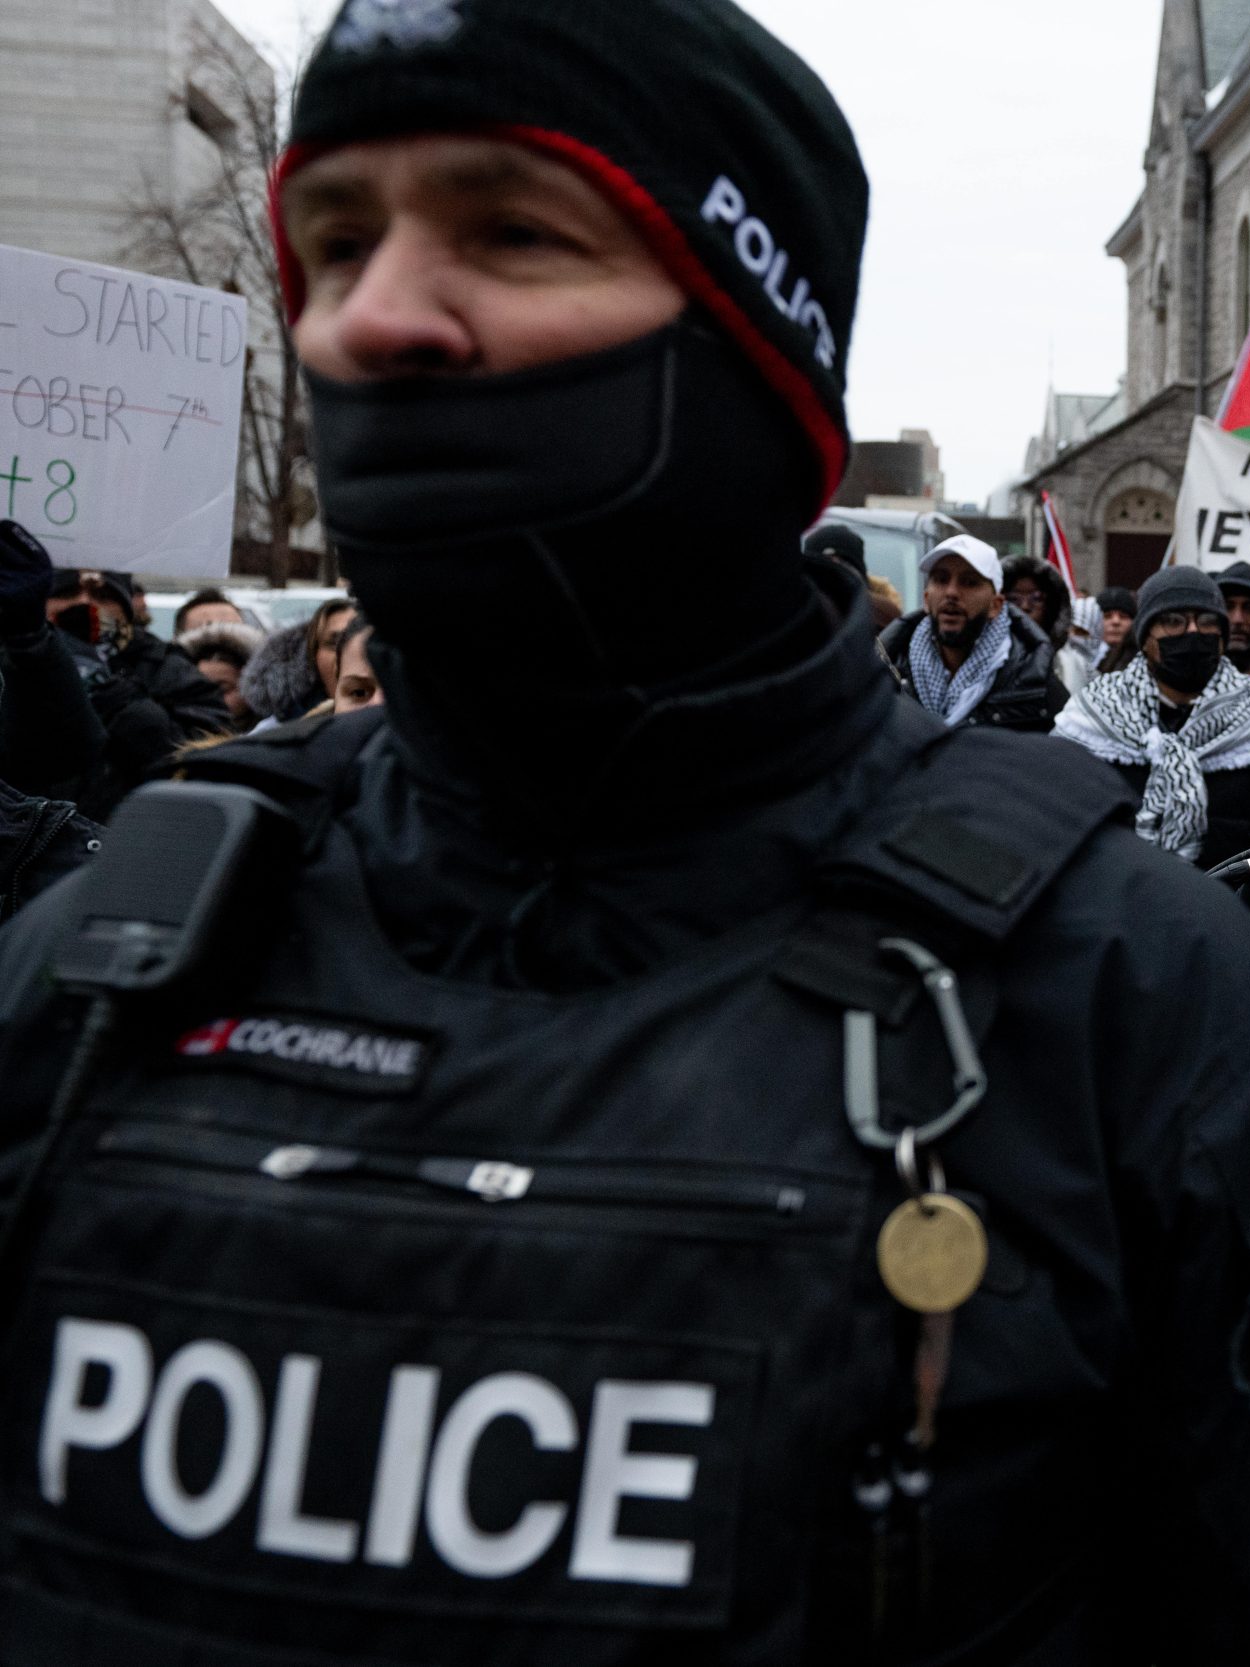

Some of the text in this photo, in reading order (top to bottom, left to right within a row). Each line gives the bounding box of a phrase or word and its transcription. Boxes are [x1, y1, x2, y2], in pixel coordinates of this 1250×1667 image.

[43, 267, 244, 369] STARTED
[0, 366, 131, 446] OBER
[38, 1315, 715, 1587] POLICE
